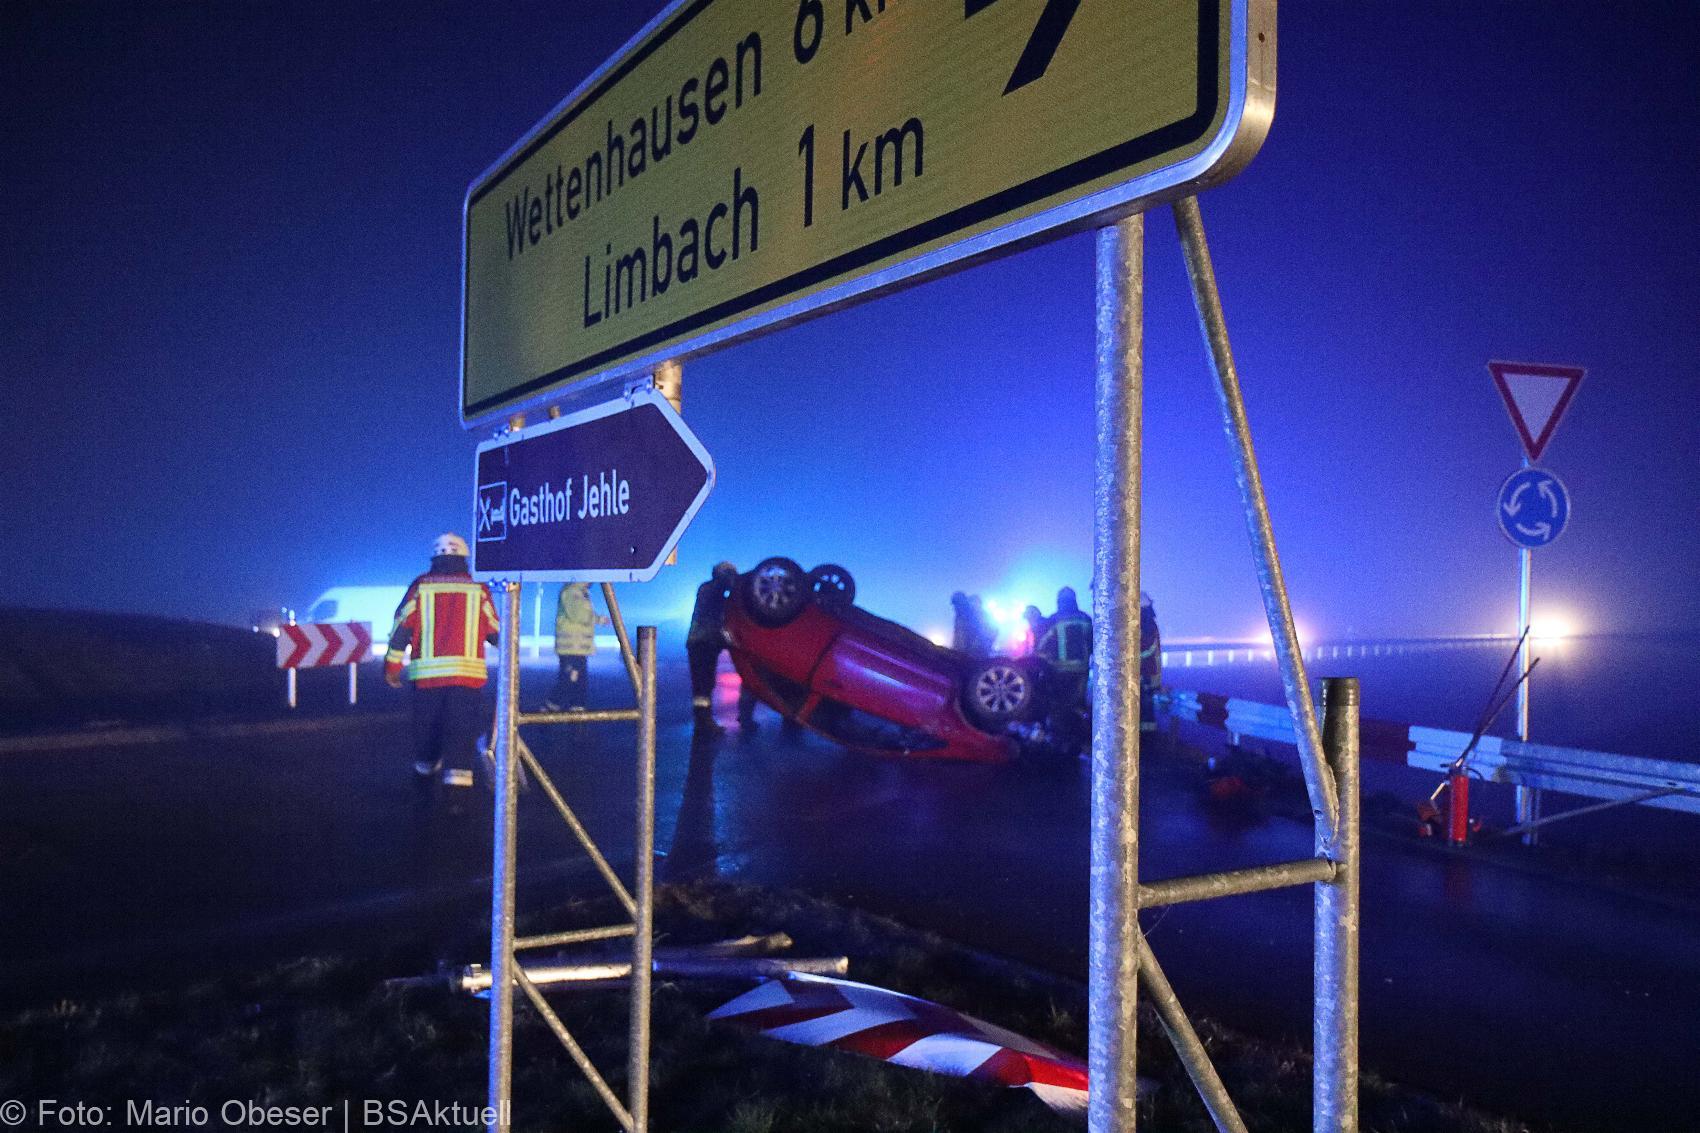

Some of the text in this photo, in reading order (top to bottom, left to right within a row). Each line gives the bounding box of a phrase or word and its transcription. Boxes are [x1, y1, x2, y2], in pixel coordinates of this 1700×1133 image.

[504, 31, 763, 261] Wettenhausen
[583, 116, 924, 329] Limbach 1 km
[509, 469, 630, 527] Gasthof Jehle
